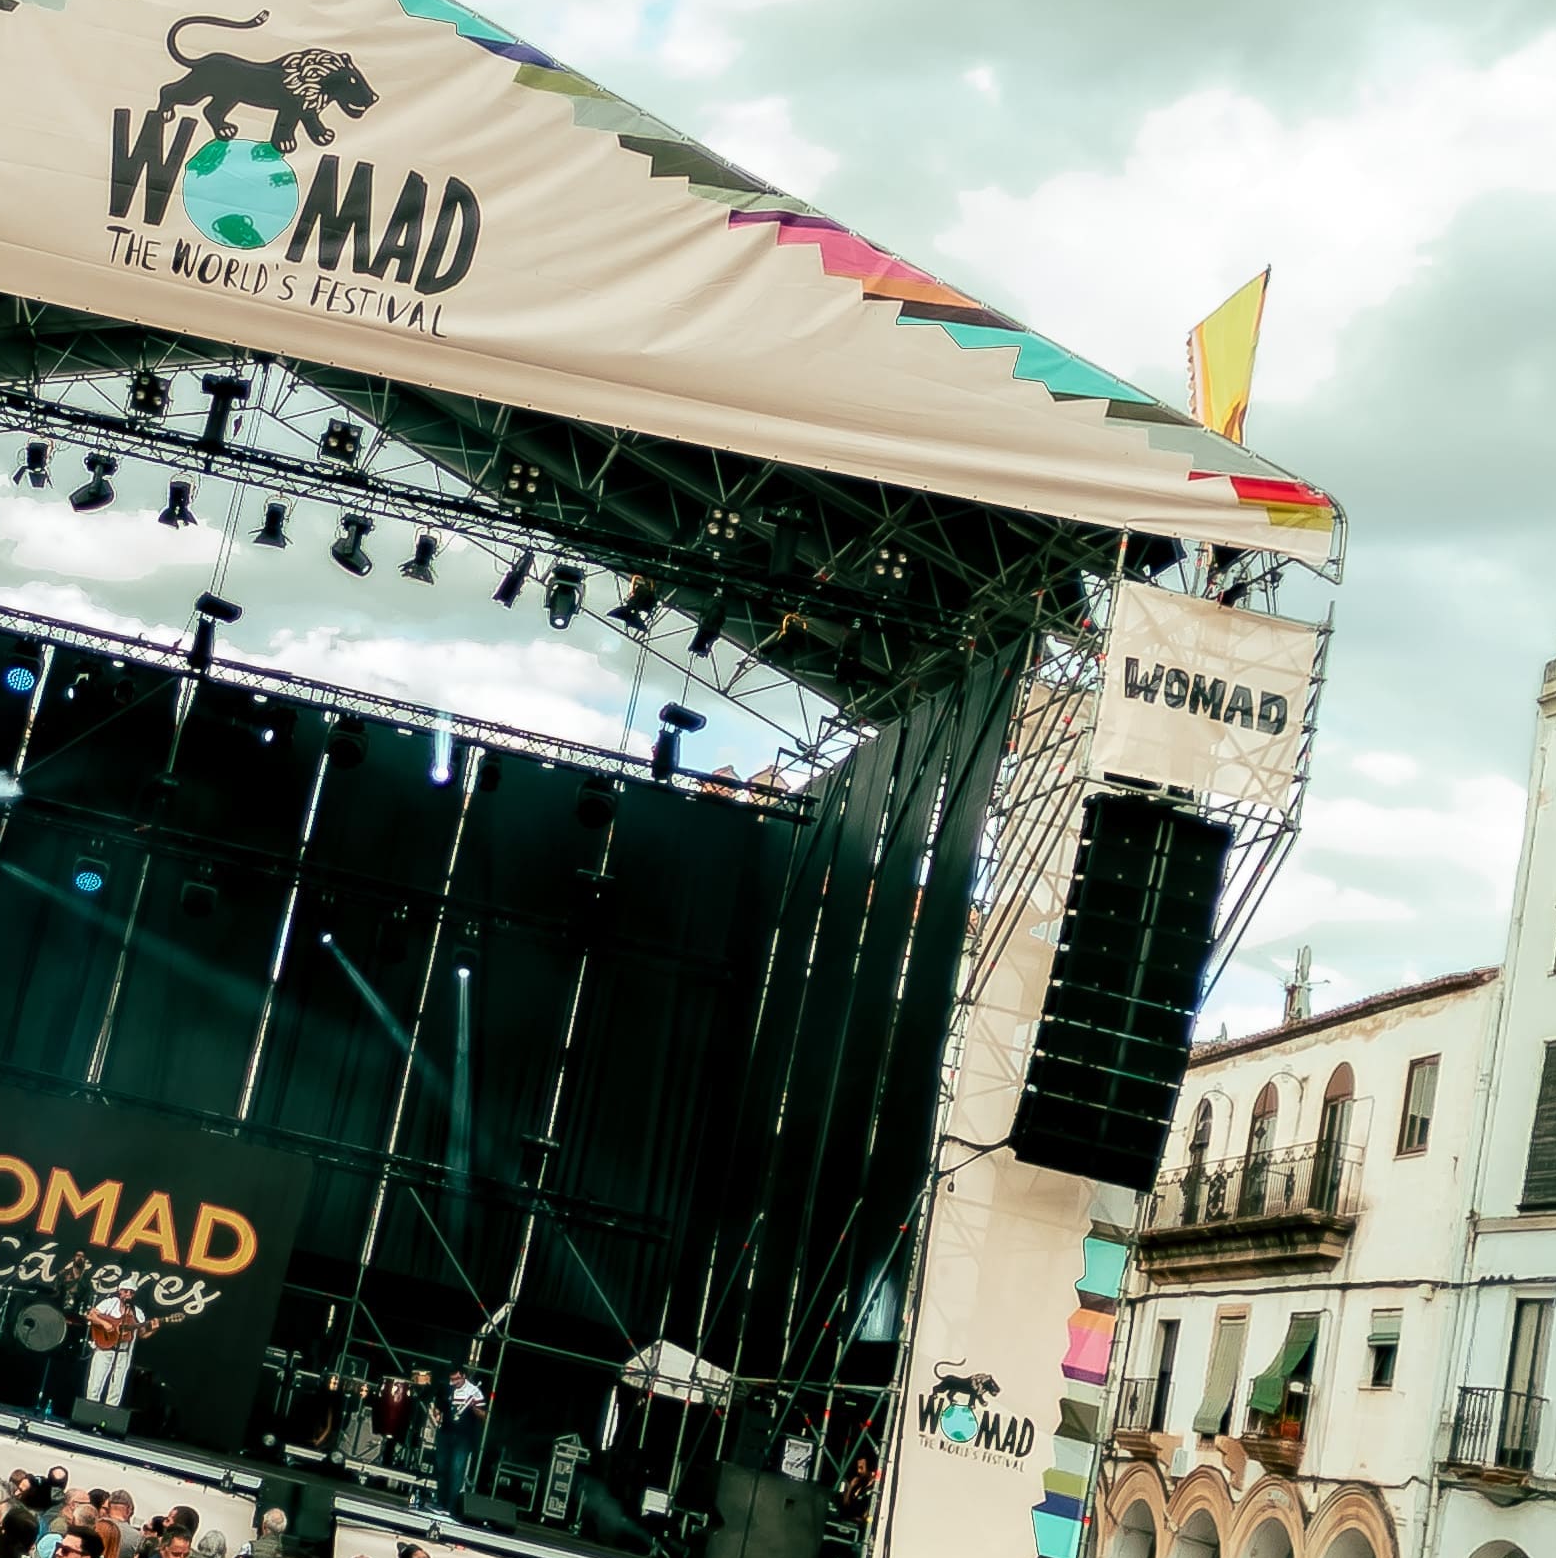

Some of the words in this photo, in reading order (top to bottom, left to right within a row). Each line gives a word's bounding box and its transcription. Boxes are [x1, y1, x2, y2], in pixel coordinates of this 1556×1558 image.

[108, 107, 481, 295] WOMAD
[105, 225, 158, 272] THE
[171, 241, 296, 301] WORLD'S
[310, 275, 449, 339] FESTIVAL
[1123, 656, 1289, 736] WOMAD
[918, 1393, 1035, 1458] WOMAD
